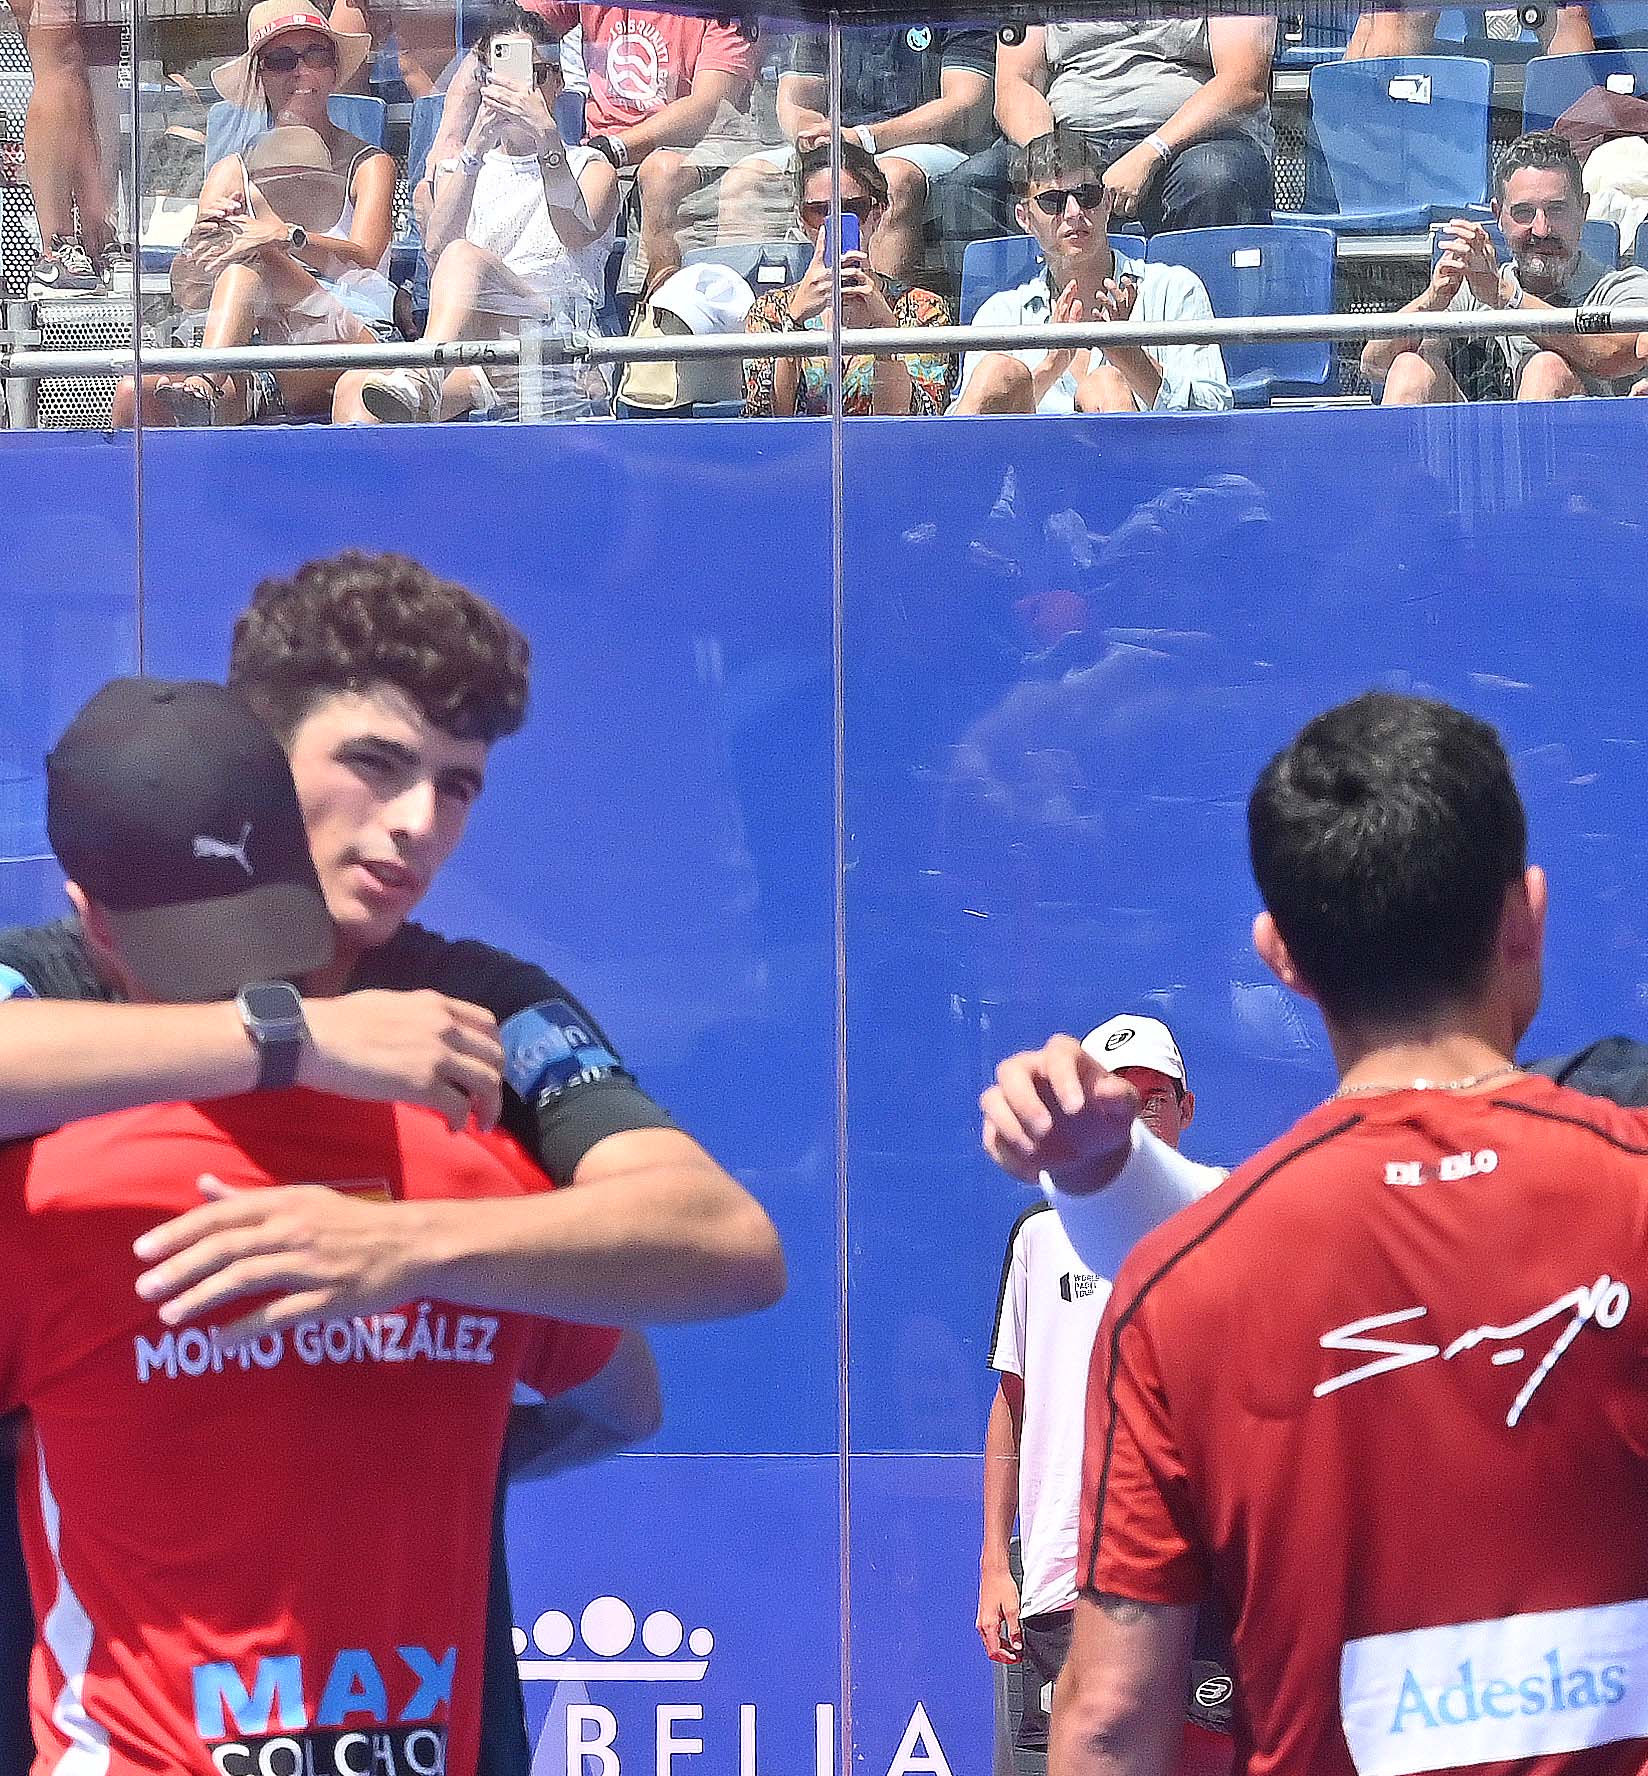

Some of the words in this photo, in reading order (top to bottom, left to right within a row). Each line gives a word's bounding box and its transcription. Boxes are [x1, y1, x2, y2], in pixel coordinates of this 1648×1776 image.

[293, 1302, 500, 1366] GONZÁLEZ
[192, 1645, 458, 1739] MAX
[1388, 1647, 1626, 1734] Adeslas
